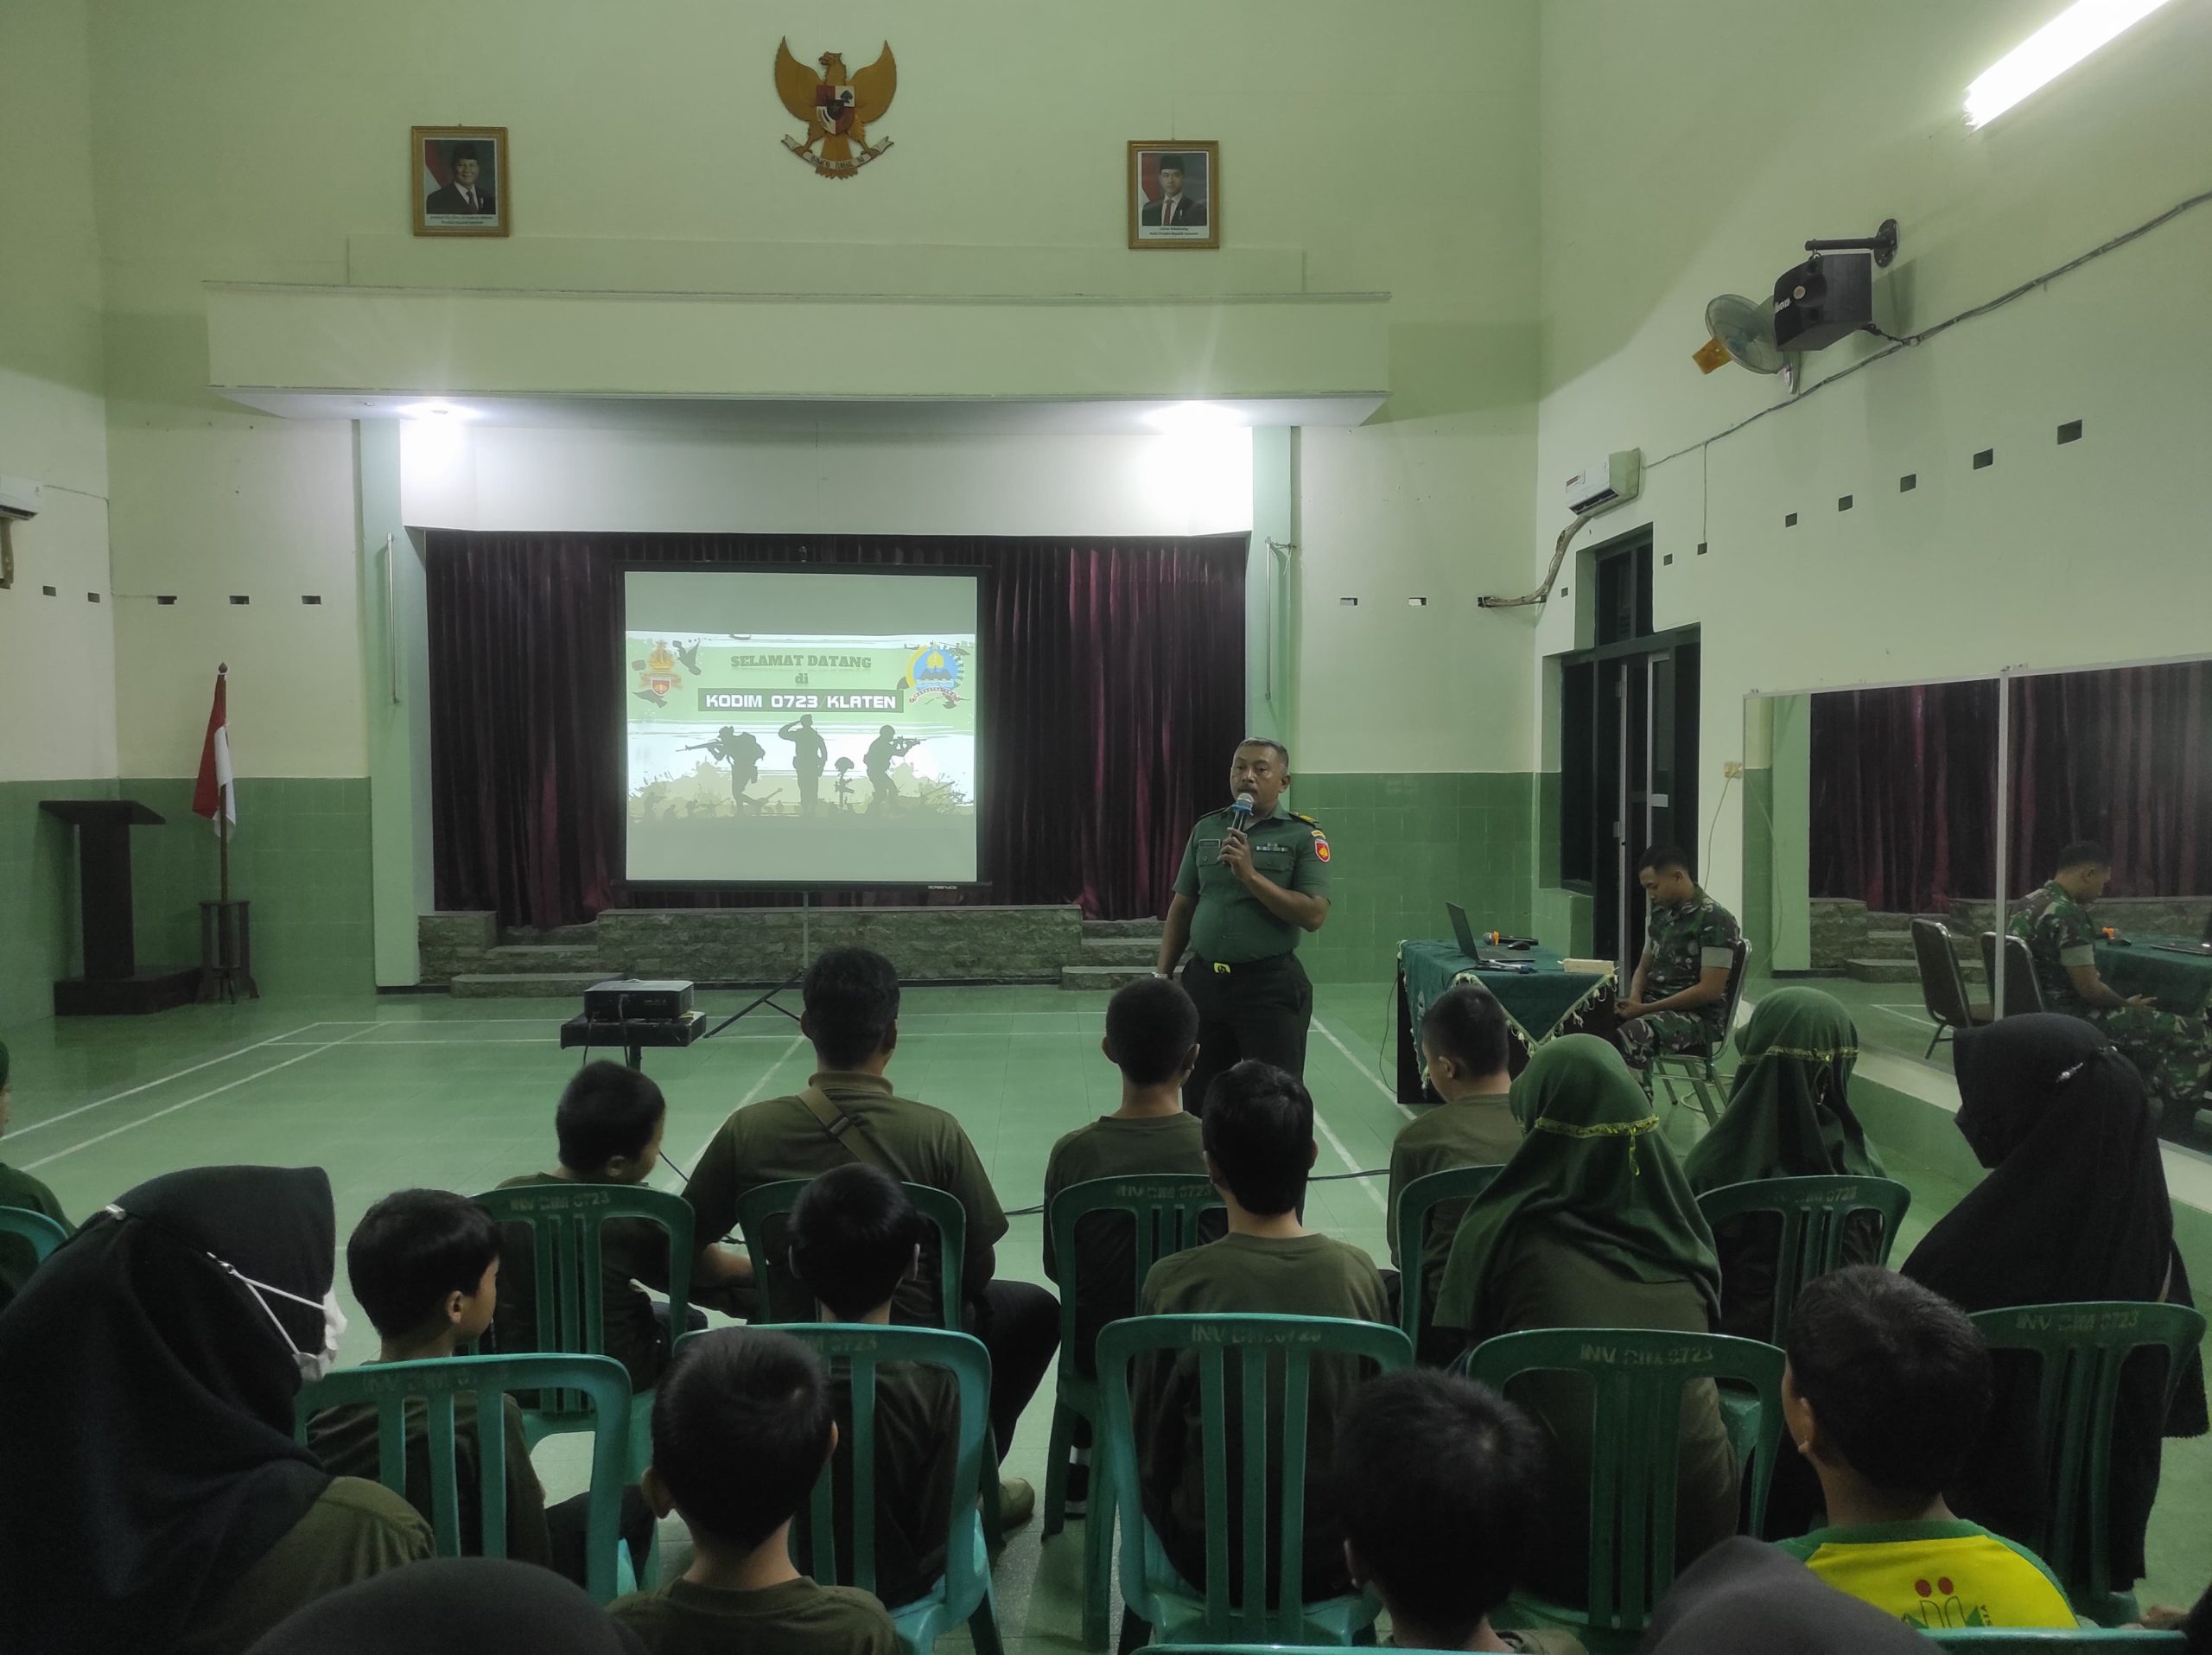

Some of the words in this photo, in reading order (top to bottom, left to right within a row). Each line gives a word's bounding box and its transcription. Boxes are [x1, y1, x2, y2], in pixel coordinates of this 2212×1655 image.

[731, 654, 804, 667] SELAMAT
[807, 655, 872, 669] DATANG
[794, 672, 809, 684] di
[705, 694, 762, 709] KODIM
[771, 694, 818, 710] 0723
[826, 695, 896, 710] KLATEN
